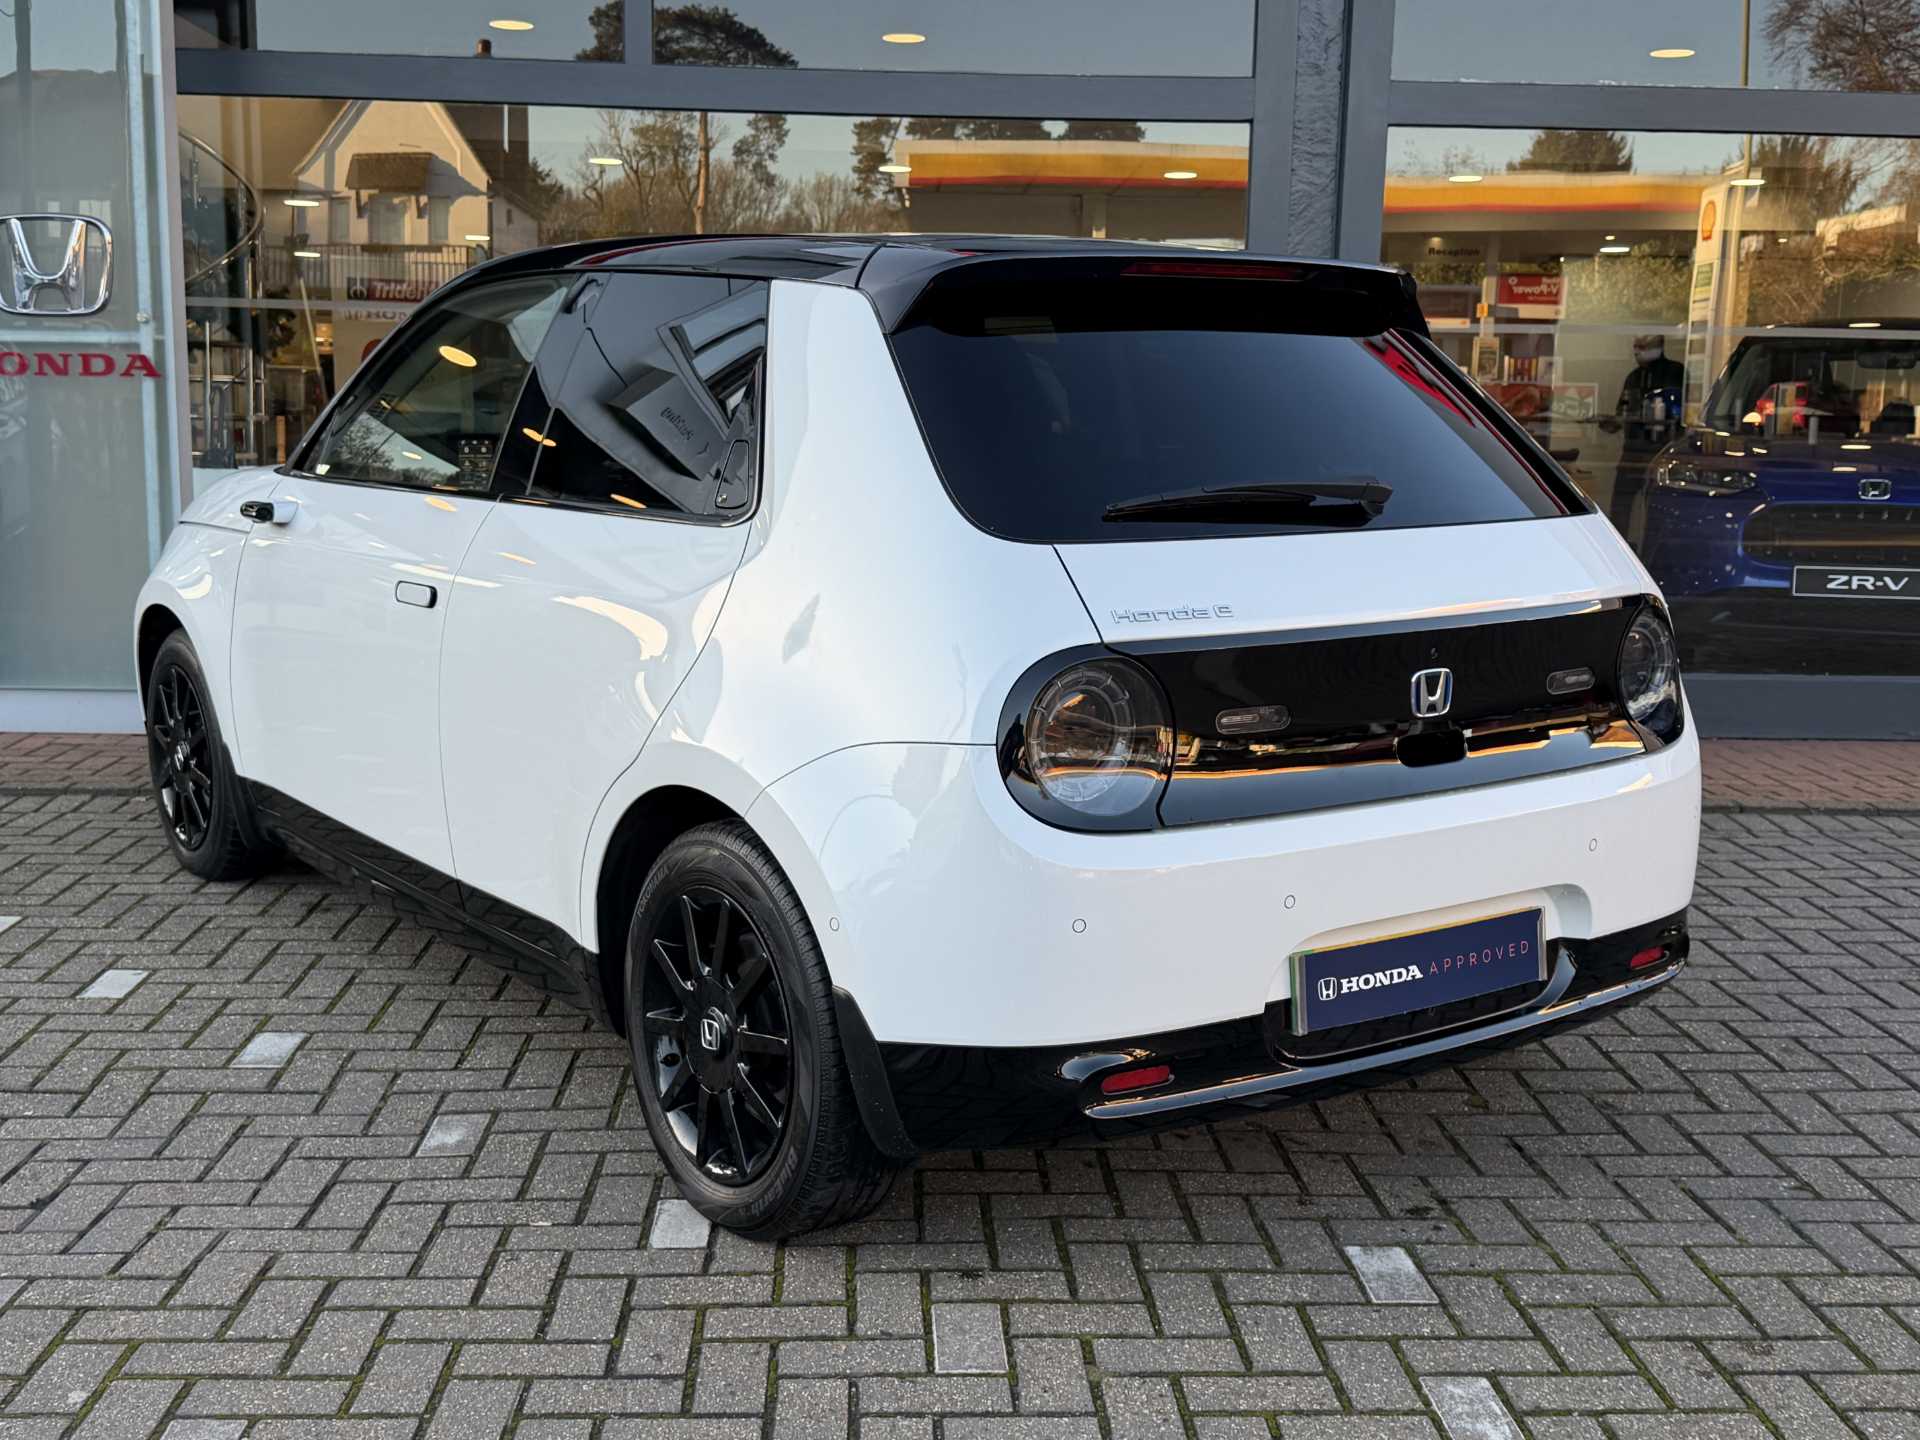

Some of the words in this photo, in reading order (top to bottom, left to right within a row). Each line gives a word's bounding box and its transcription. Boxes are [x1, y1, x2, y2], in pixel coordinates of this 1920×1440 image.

[0, 351, 163, 378] ONDA
[1826, 574, 1909, 591] ZR-V
[1110, 601, 1211, 624] Honda
[1340, 965, 1424, 994] HONDA
[1429, 940, 1530, 977] APPROVED
